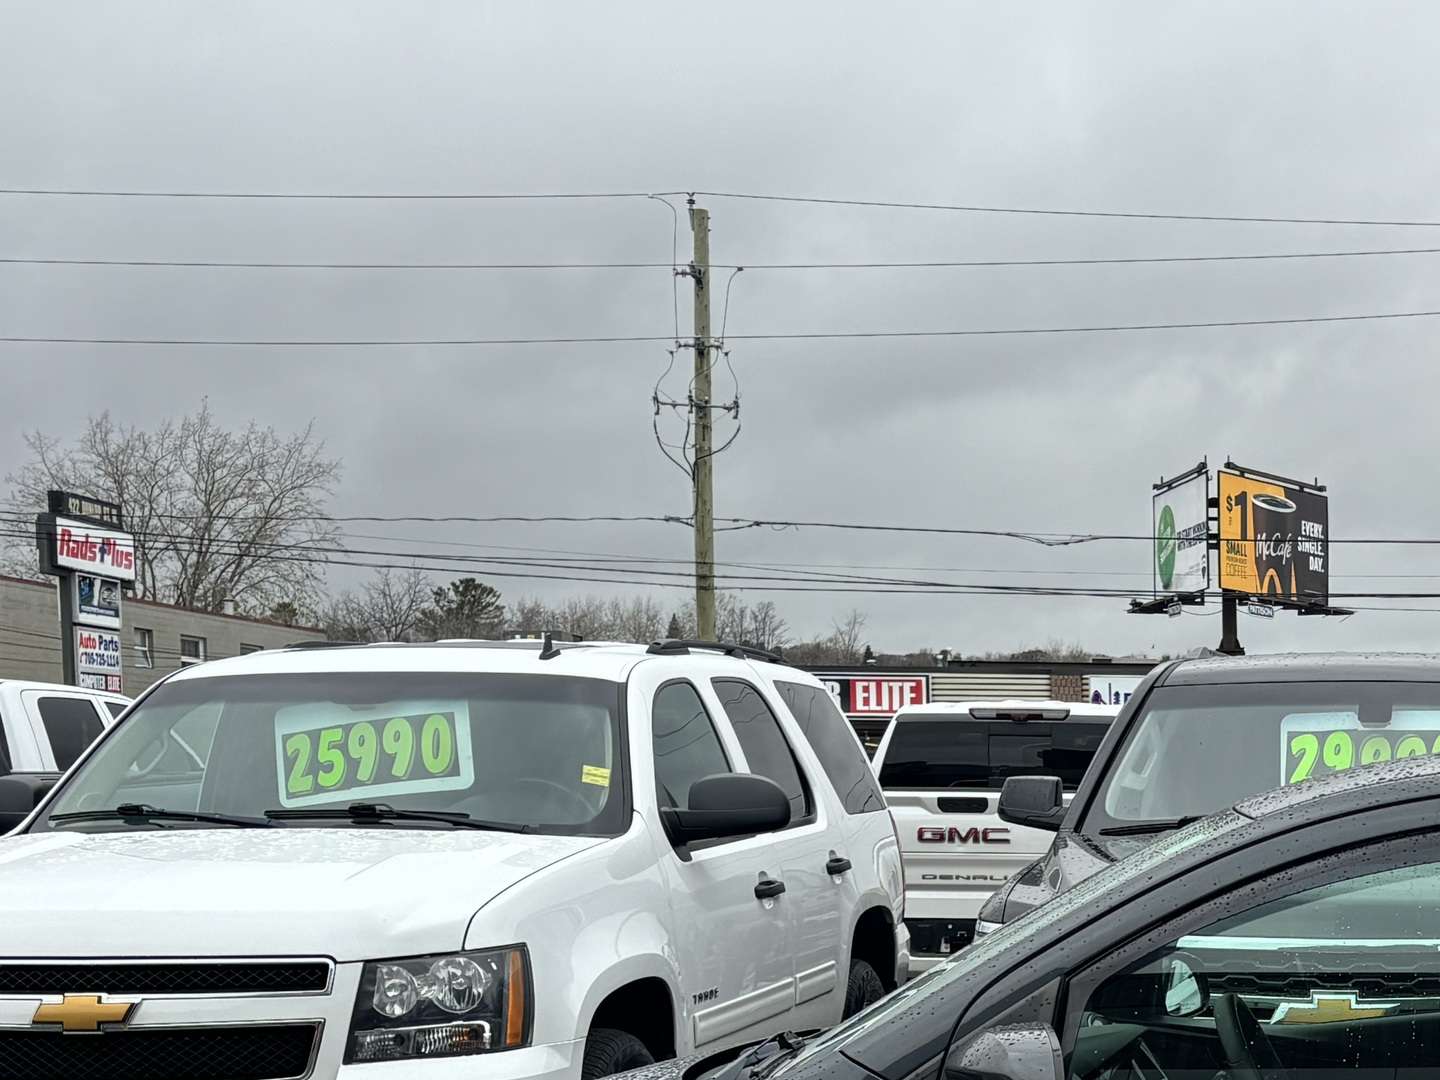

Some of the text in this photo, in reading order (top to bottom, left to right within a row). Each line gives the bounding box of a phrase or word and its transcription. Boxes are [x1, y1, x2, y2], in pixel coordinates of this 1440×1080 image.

[1301, 520, 1325, 539] EVERY.
[59, 528, 133, 570] Rads Plus
[1226, 540, 1248, 558] SMALL
[1297, 536, 1325, 556] SINGLE.
[1309, 556, 1325, 573] DAY.
[80, 633, 120, 653] Auto Parts
[855, 680, 918, 711] ELITE
[286, 712, 455, 795] 25990
[917, 827, 1011, 844] GMC
[921, 873, 1008, 881] DENALI
